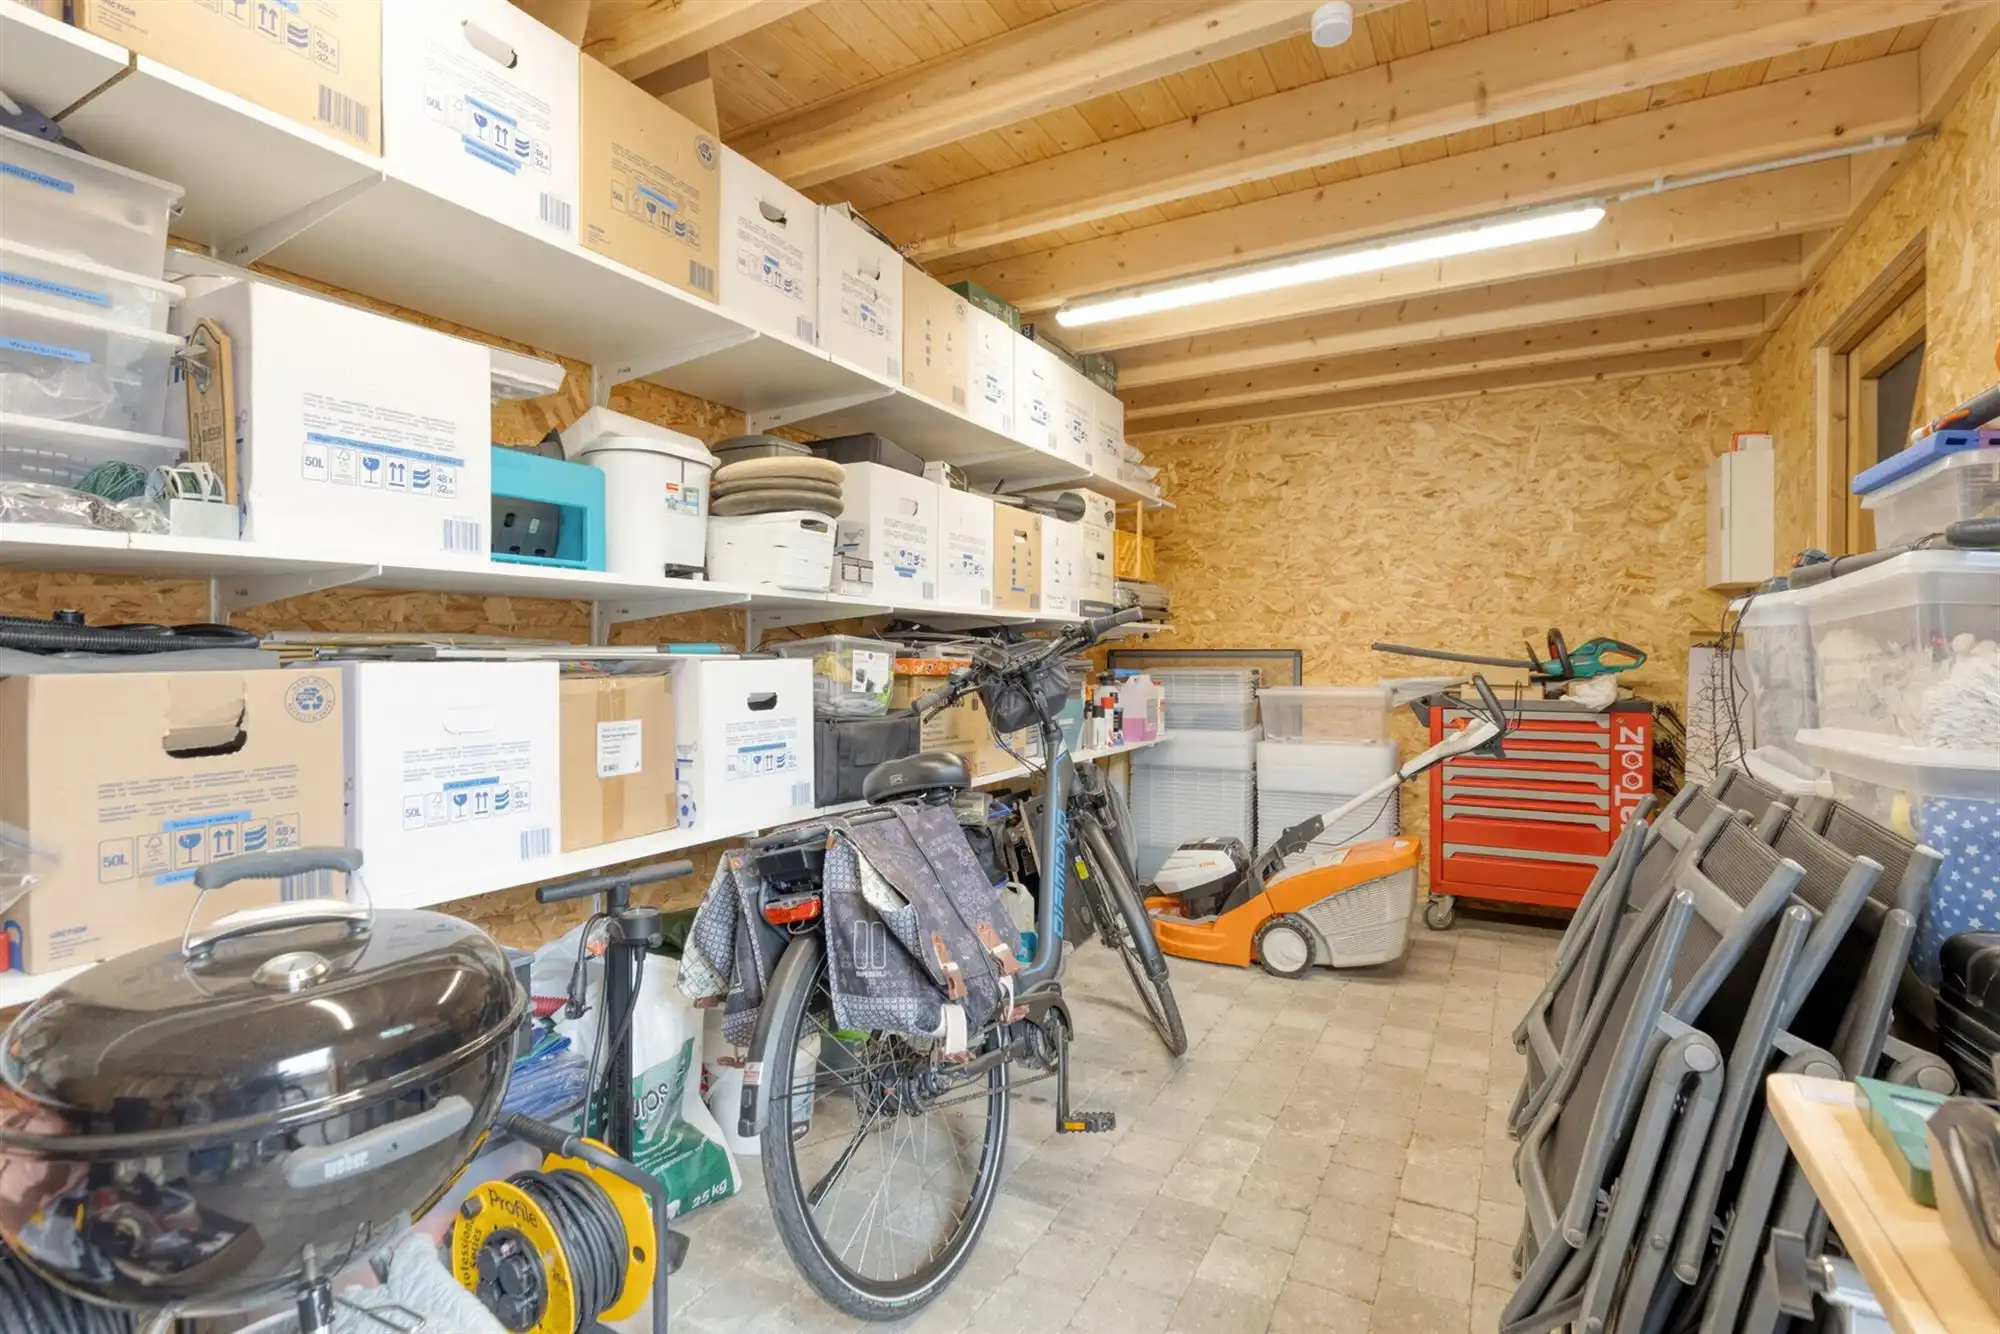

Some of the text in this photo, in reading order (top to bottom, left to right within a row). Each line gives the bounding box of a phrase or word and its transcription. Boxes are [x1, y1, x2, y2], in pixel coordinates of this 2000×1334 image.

[304, 455, 324, 469] 50L
[405, 808, 422, 819] 50L
[275, 826, 288, 836] 48
[103, 852, 129, 869] 50L
[711, 1178, 728, 1198] kg
[488, 1187, 539, 1229] Profile
